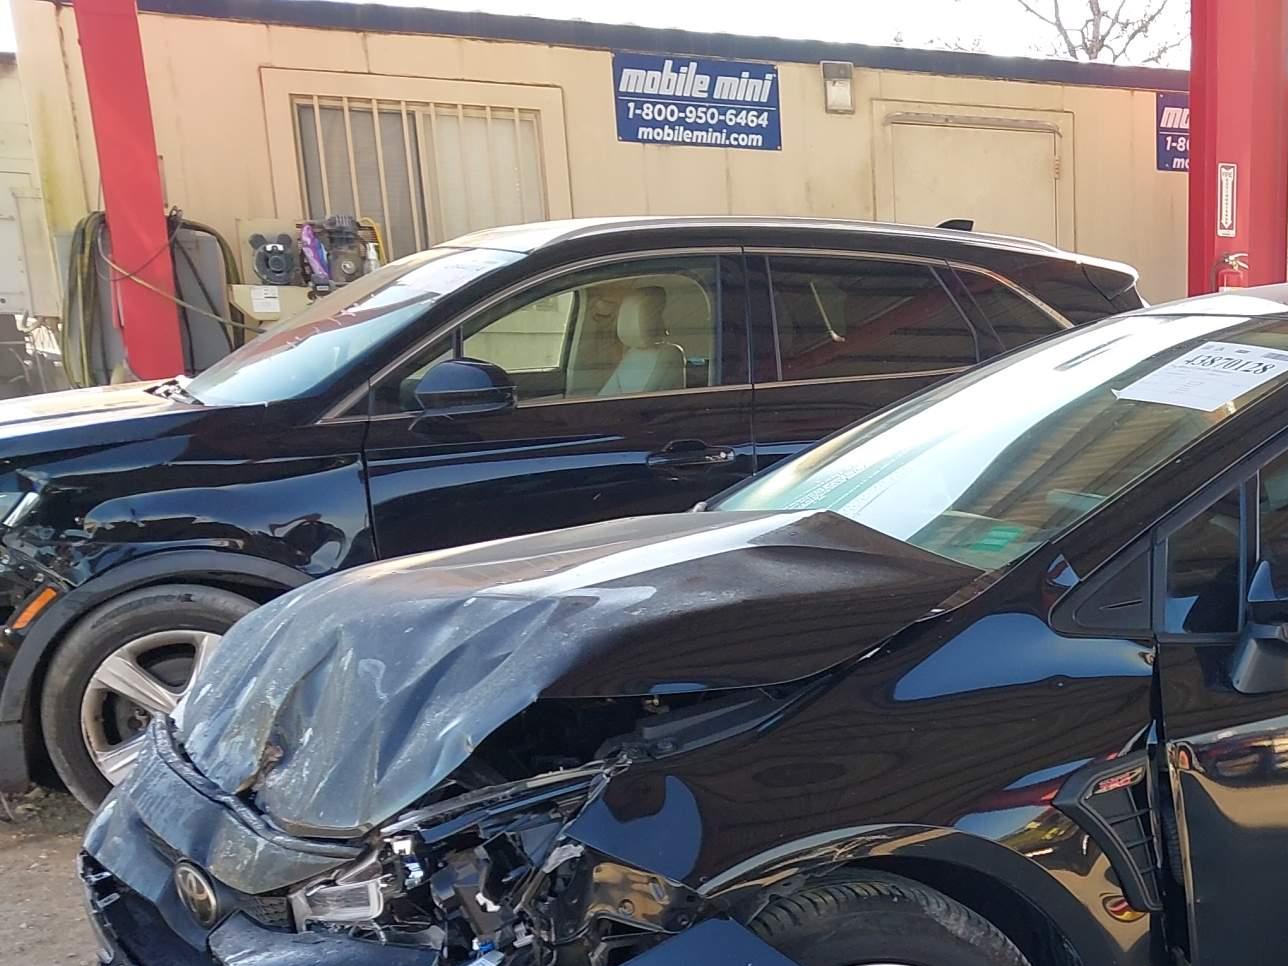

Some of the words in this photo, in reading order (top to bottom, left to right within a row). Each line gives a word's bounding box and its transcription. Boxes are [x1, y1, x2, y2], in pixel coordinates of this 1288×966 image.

[618, 59, 711, 98] mobile
[713, 71, 774, 103] mini
[627, 102, 769, 128] 1-800-950-6464
[637, 125, 763, 147] mobilemini.com
[1184, 354, 1276, 375] 43870128
